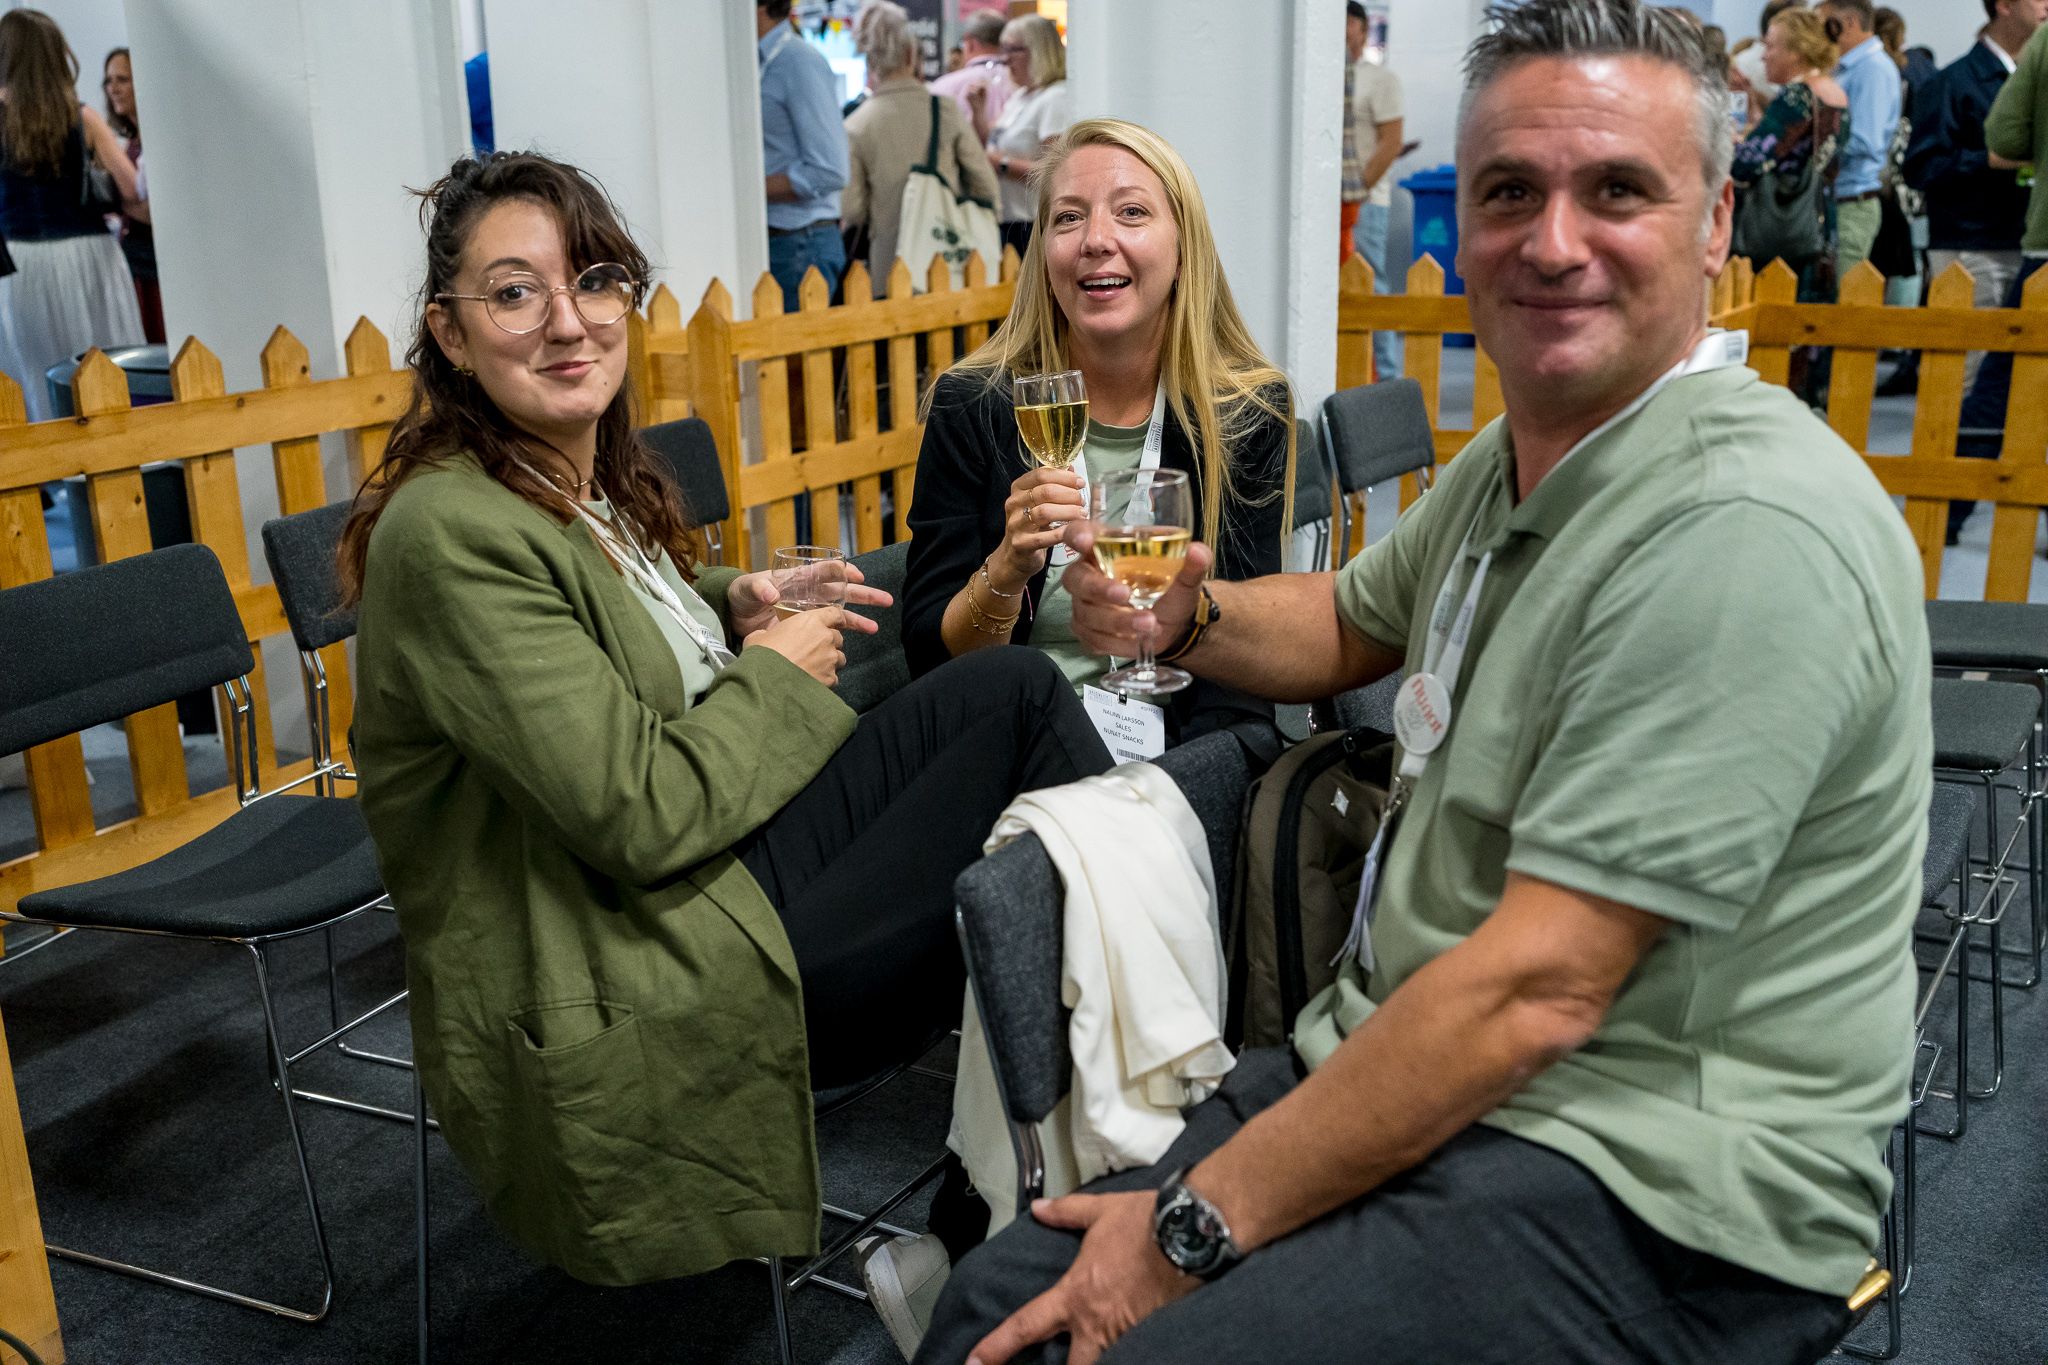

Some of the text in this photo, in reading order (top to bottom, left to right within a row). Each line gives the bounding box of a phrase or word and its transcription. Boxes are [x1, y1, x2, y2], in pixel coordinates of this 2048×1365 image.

[1121, 716, 1144, 726] LARSSON
[1115, 722, 1132, 732] SALES
[1103, 727, 1144, 745] NUNAT SNACKS
